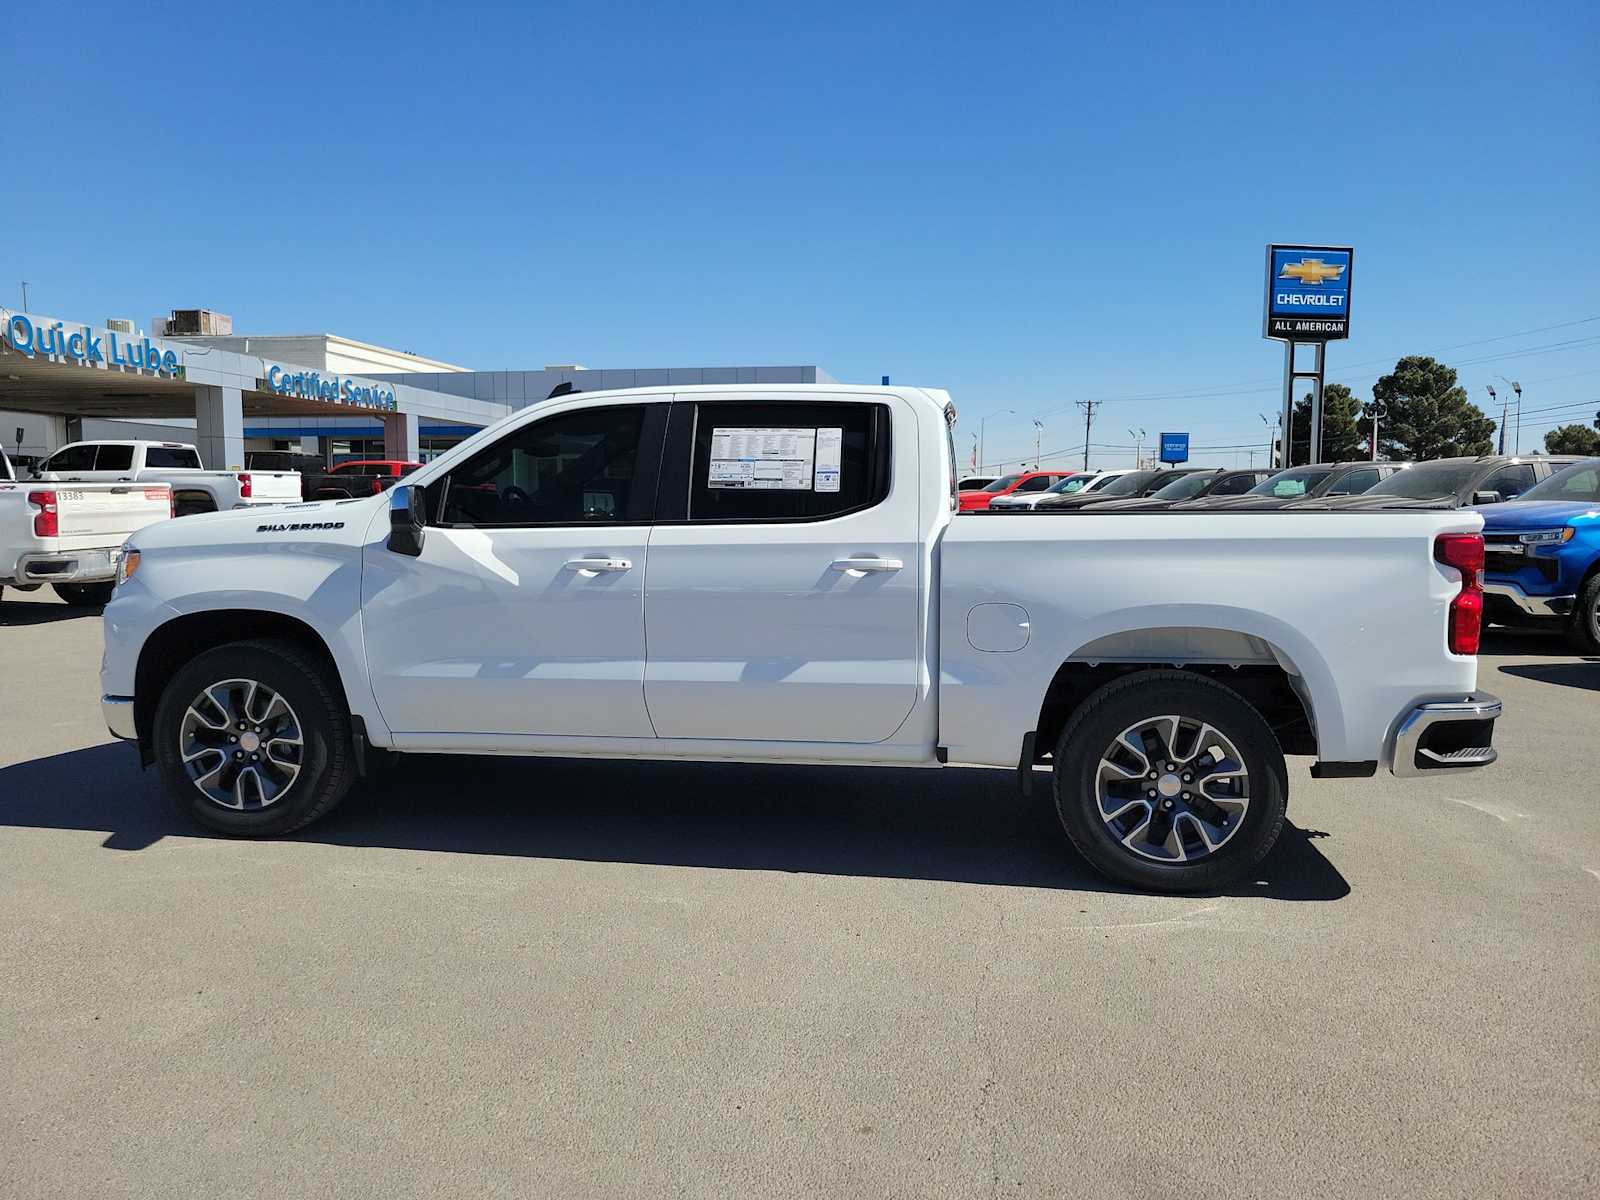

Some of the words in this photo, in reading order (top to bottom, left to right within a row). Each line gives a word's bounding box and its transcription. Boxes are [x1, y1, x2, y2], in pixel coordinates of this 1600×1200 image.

[1276, 294, 1344, 306] CHEVROLET
[1275, 321, 1292, 331] ALL
[1295, 321, 1344, 332] AMERICAN
[7, 315, 104, 362] Quick
[109, 332, 178, 373] Lube
[268, 365, 339, 401] Certified
[342, 379, 394, 410] Service
[256, 522, 345, 533] SILVERADO
